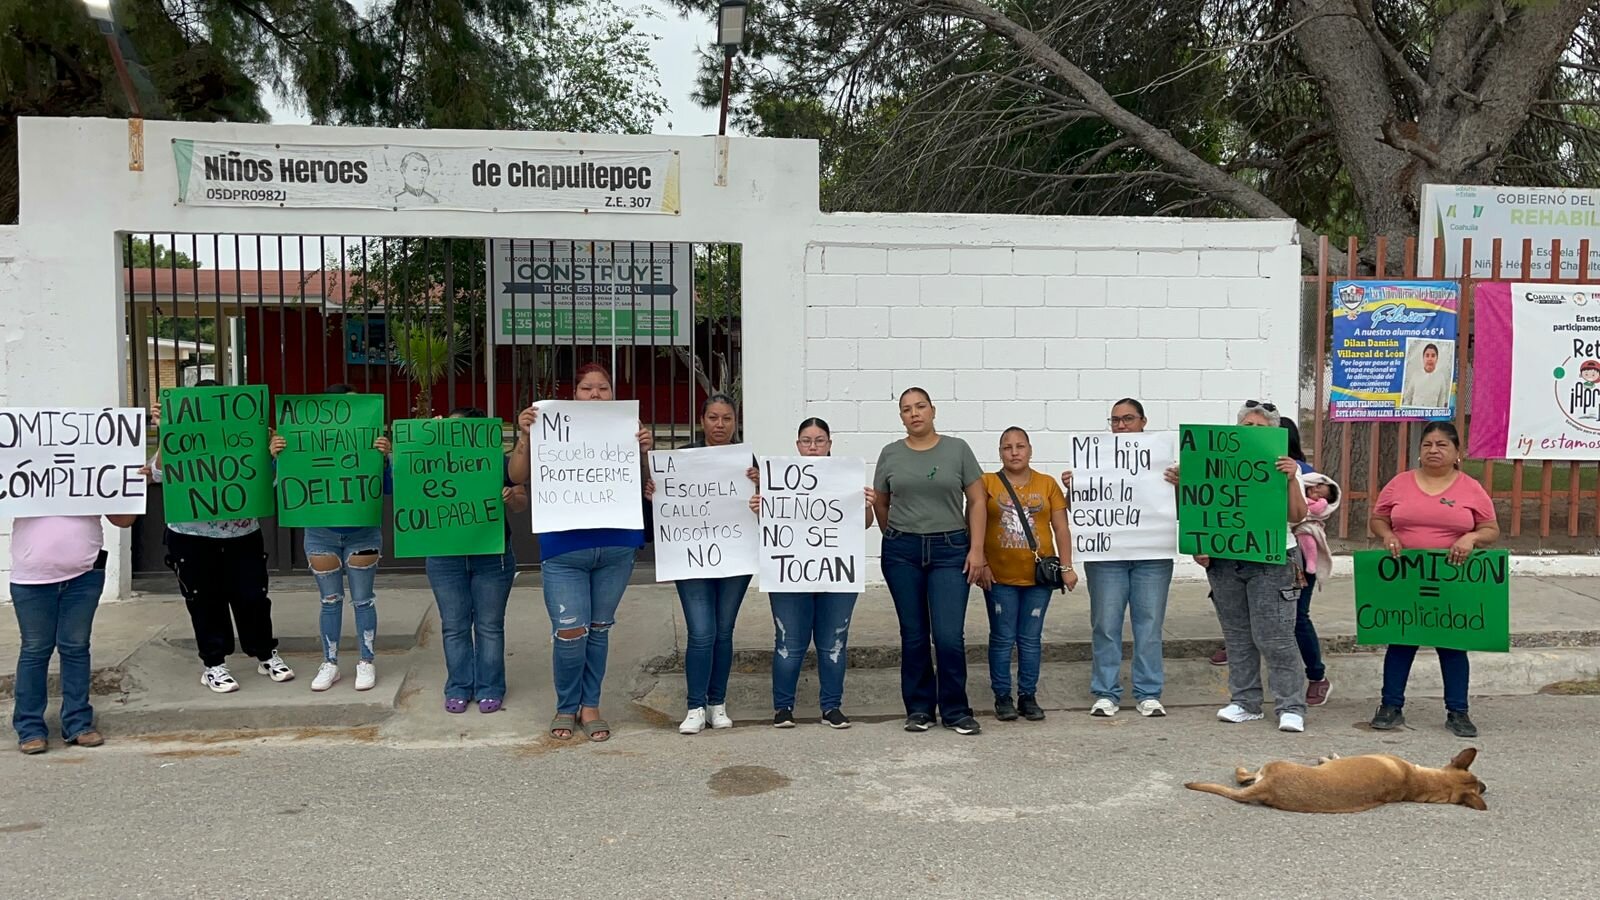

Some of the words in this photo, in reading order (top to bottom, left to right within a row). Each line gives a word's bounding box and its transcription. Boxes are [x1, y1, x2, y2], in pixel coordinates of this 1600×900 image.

[204, 151, 273, 183] Niños
[279, 157, 368, 184] Heroes
[472, 159, 501, 187] de
[508, 161, 652, 192] Chapultepec
[207, 188, 286, 202] 05DPR0982J
[605, 196, 627, 208] Z.E.
[631, 197, 652, 208] 307
[1497, 193, 1566, 205] GOBIERNO
[1571, 195, 1594, 206] DEL
[517, 263, 663, 281] CONSTRUYE
[1343, 339, 1366, 347] Dilan
[1367, 339, 1399, 347] Damián
[1392, 328, 1421, 336] alumno
[1374, 349, 1384, 358] de
[1385, 349, 1405, 358] León
[280, 399, 351, 425] ACOSO
[395, 422, 417, 444] EL
[422, 422, 504, 449] SILENCIO
[542, 411, 572, 442] Mi
[537, 442, 596, 463] Escuela
[600, 441, 635, 464] debe
[1180, 429, 1197, 452] A
[1209, 430, 1241, 452] LOS
[401, 450, 492, 476] Tambien
[652, 455, 676, 474] LA
[1072, 435, 1100, 470] Mi
[1115, 435, 1151, 476] hija
[164, 452, 257, 485] NIÑOS
[766, 460, 818, 490] LOS
[1206, 456, 1270, 483] NIÑOS
[281, 474, 383, 511] DELITO
[423, 478, 458, 498] es
[538, 490, 558, 504] NO
[563, 488, 617, 505] CALLAR
[665, 477, 738, 498] ESCUELA
[1120, 478, 1133, 502] la
[1183, 485, 1214, 508] NO
[1219, 484, 1250, 508] SE
[188, 483, 248, 520] NO
[761, 492, 844, 523] NIÑOS
[395, 498, 500, 533] CULPABLE
[1073, 505, 1141, 527] escuela
[1203, 510, 1246, 529] LES
[763, 524, 794, 548] NO
[806, 526, 838, 548] SE
[1185, 530, 1282, 562] TOCA!!
[687, 543, 722, 568] NO
[1377, 550, 1506, 585] OMISIÓN
[771, 555, 856, 584] TOCAN
[1356, 602, 1485, 640] Complicidad
